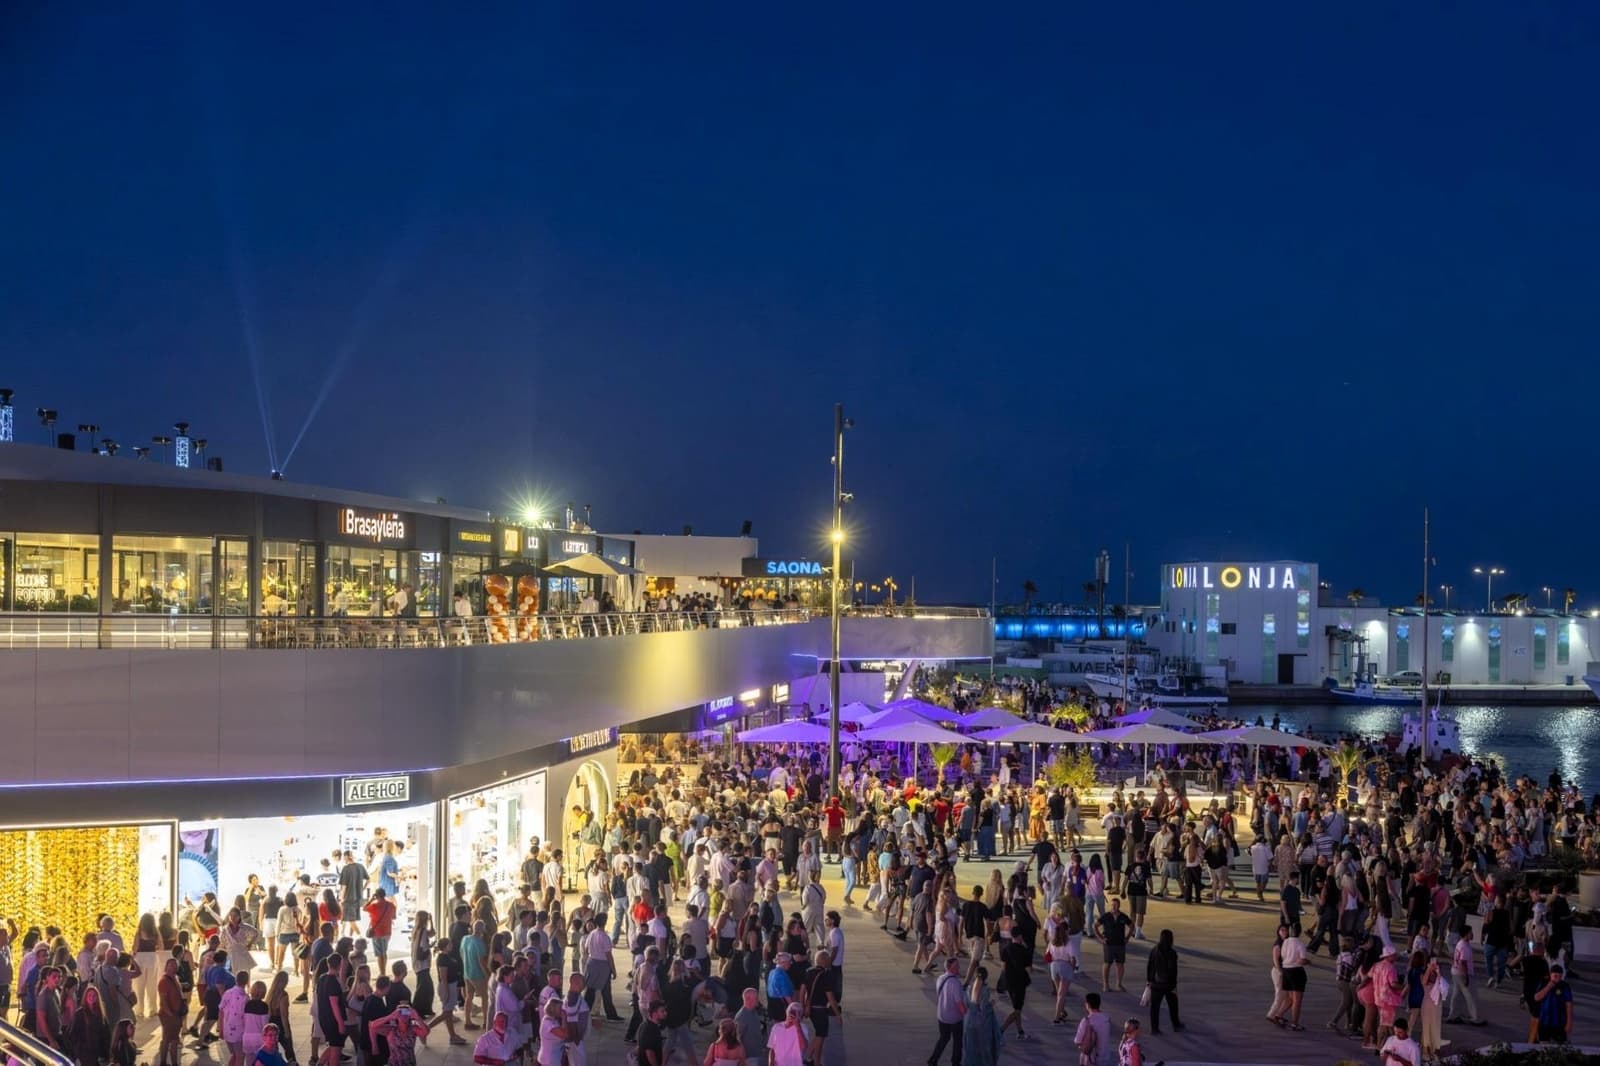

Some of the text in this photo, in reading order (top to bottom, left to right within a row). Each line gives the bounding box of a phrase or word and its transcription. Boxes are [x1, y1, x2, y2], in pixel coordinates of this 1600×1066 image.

[345, 508, 405, 543] Brasayleña
[767, 561, 822, 575] SAONA
[1172, 566, 1197, 588] LONJA
[1203, 566, 1295, 589] LONJA
[1070, 661, 1136, 674] MAER
